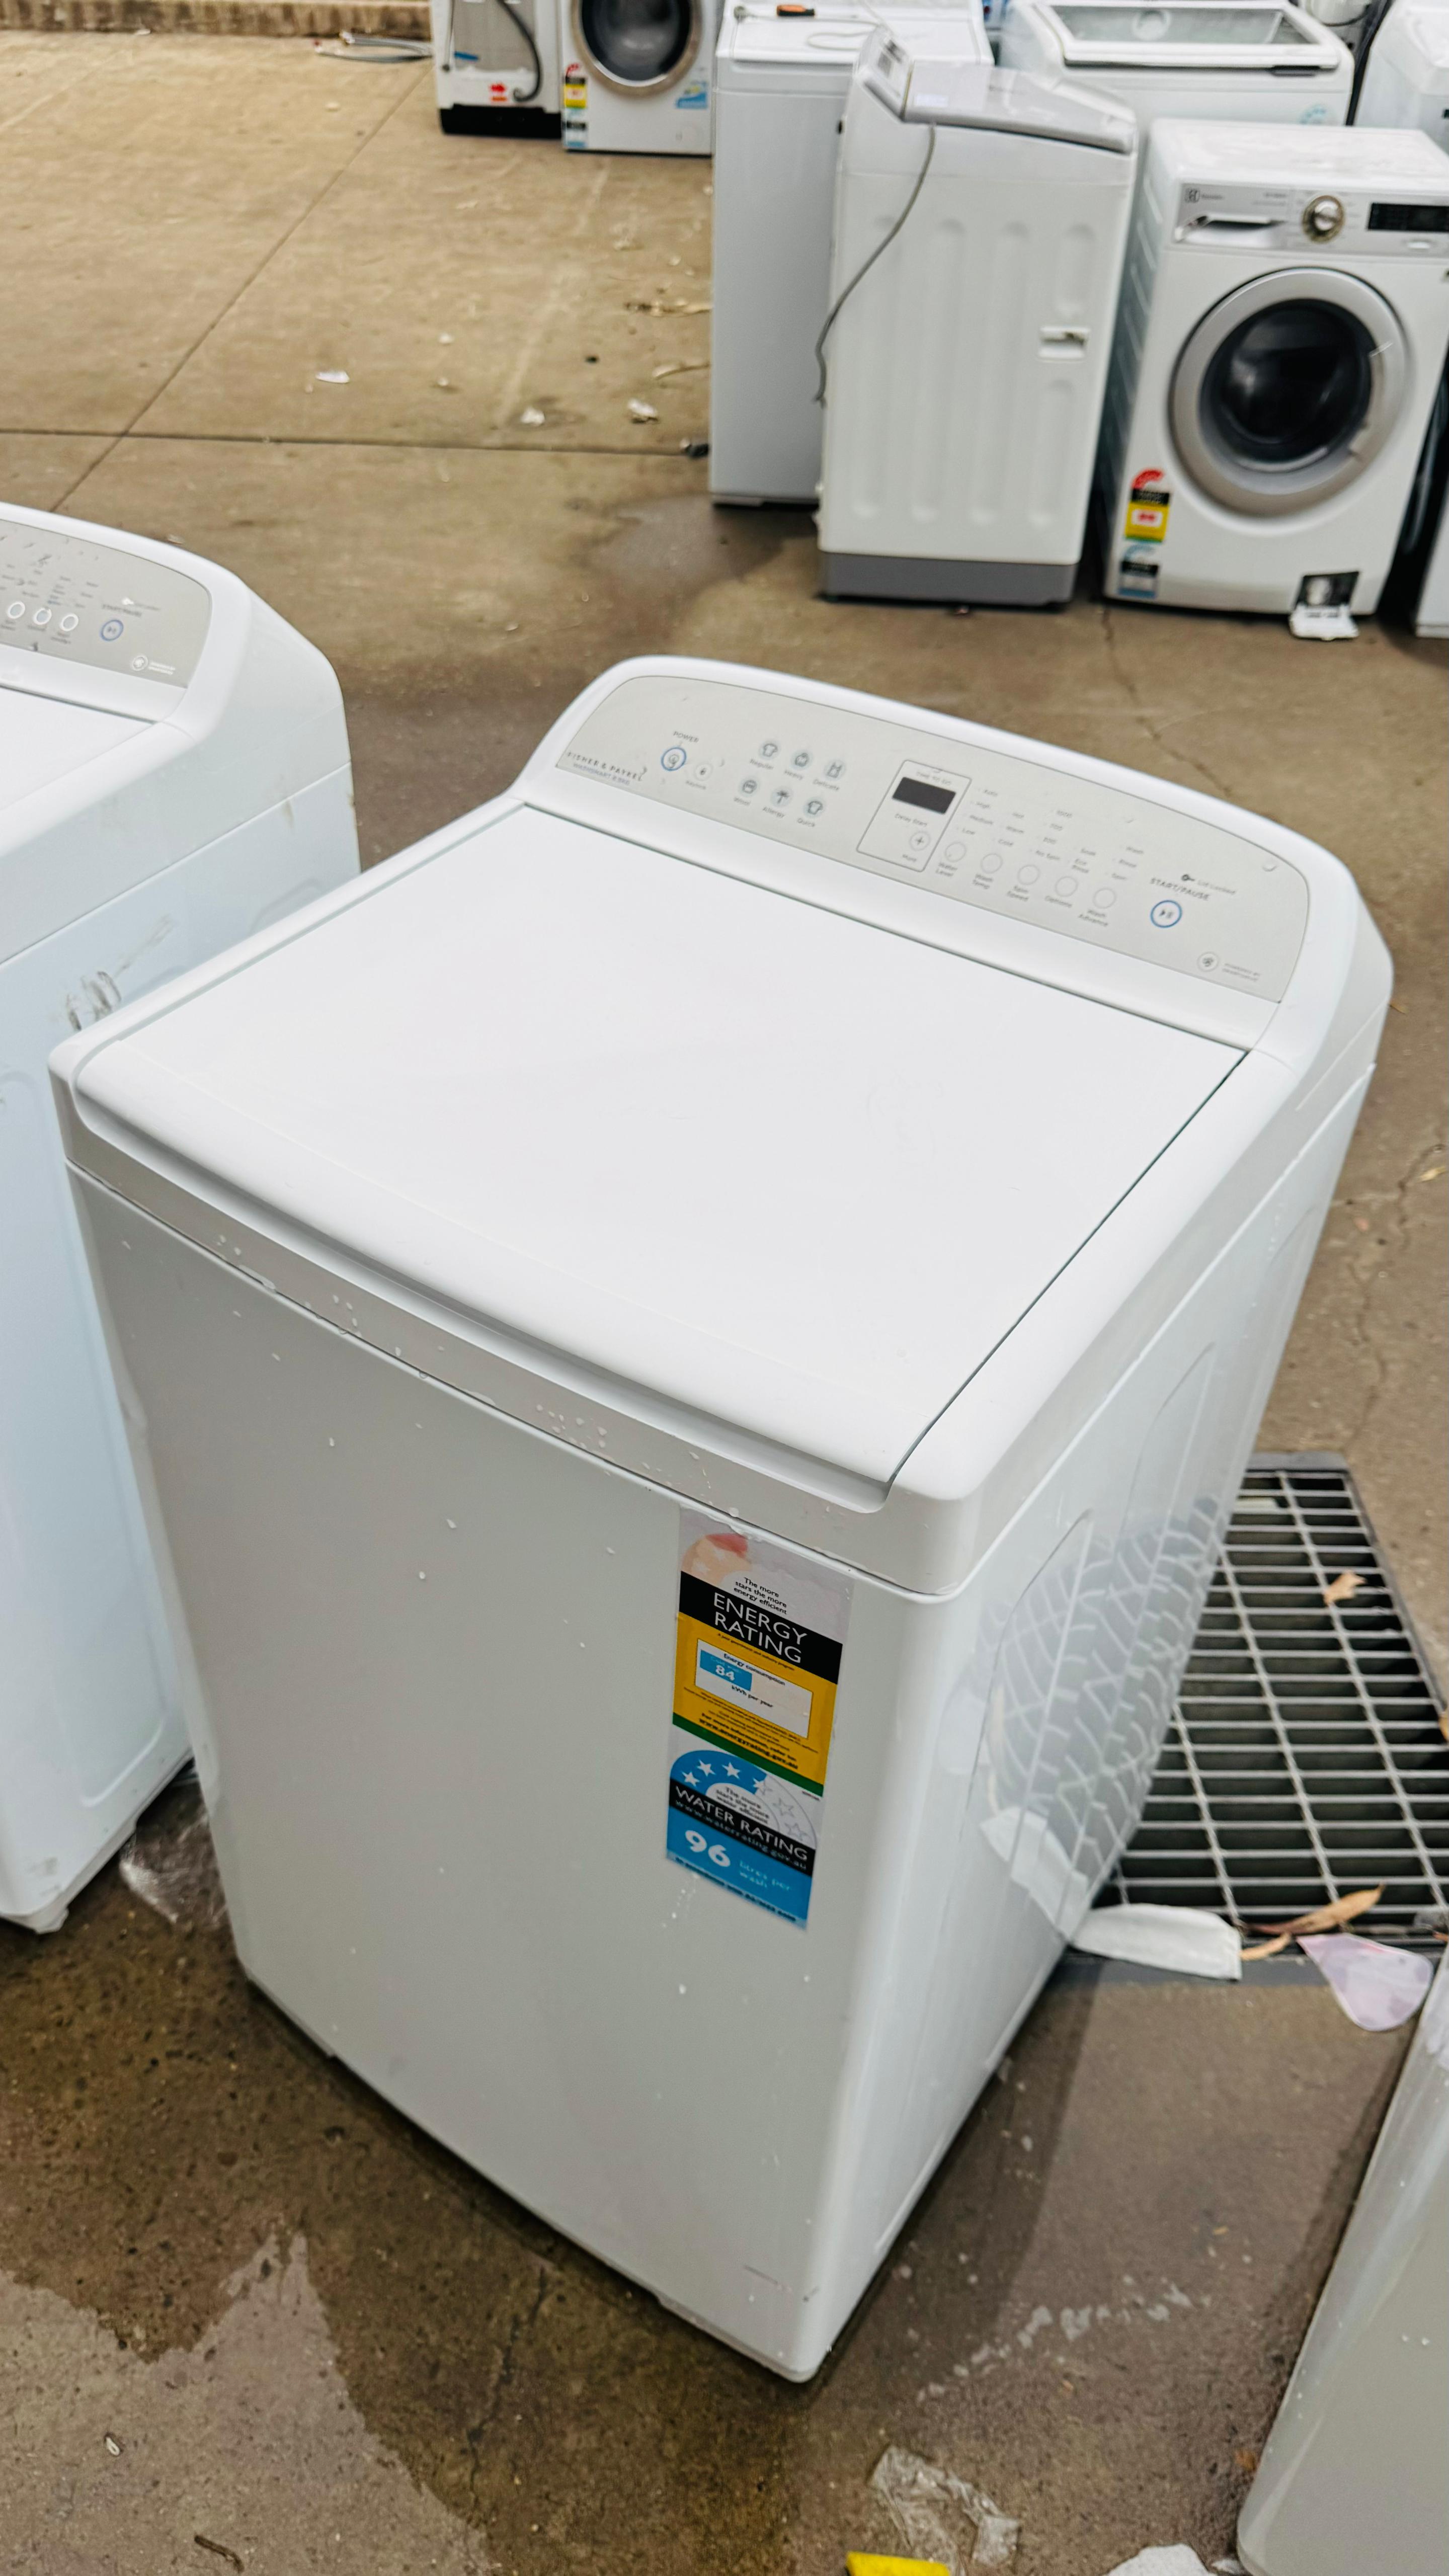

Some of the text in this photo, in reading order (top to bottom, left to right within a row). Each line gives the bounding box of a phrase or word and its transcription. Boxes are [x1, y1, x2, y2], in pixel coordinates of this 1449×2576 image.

[673, 731, 699, 743] POWER
[567, 751, 599, 766] FISHER
[610, 764, 643, 782] PAYKEL
[750, 759, 774, 770] Regular
[784, 769, 803, 780] Heavy
[813, 779, 840, 791] Delicate
[734, 796, 751, 806] Wool
[761, 807, 785, 818] Allergy
[796, 817, 815, 827] Quick
[895, 814, 912, 823] Delay
[998, 838, 1014, 847] Cold
[1150, 876, 1211, 901] START/PAUSE
[735, 1581, 787, 1607] stars the more
[744, 1577, 779, 1598] The more
[734, 1587, 787, 1615] energy efficient
[713, 1592, 808, 1645] ENERGY
[714, 1612, 801, 1663] RATING
[715, 1665, 735, 1681] 84
[724, 1653, 745, 1667] Energy
[746, 1665, 786, 1685] consumption
[732, 1684, 747, 1696] kWh
[760, 1700, 774, 1708] year
[675, 1786, 735, 1826] WATER
[716, 1789, 770, 1819] stars the more
[725, 1786, 761, 1809] The more
[675, 1800, 807, 1870] www.waterrating.gov.au
[740, 1819, 808, 1861] RATING
[685, 1830, 731, 1868] 96
[771, 1878, 791, 1892] per
